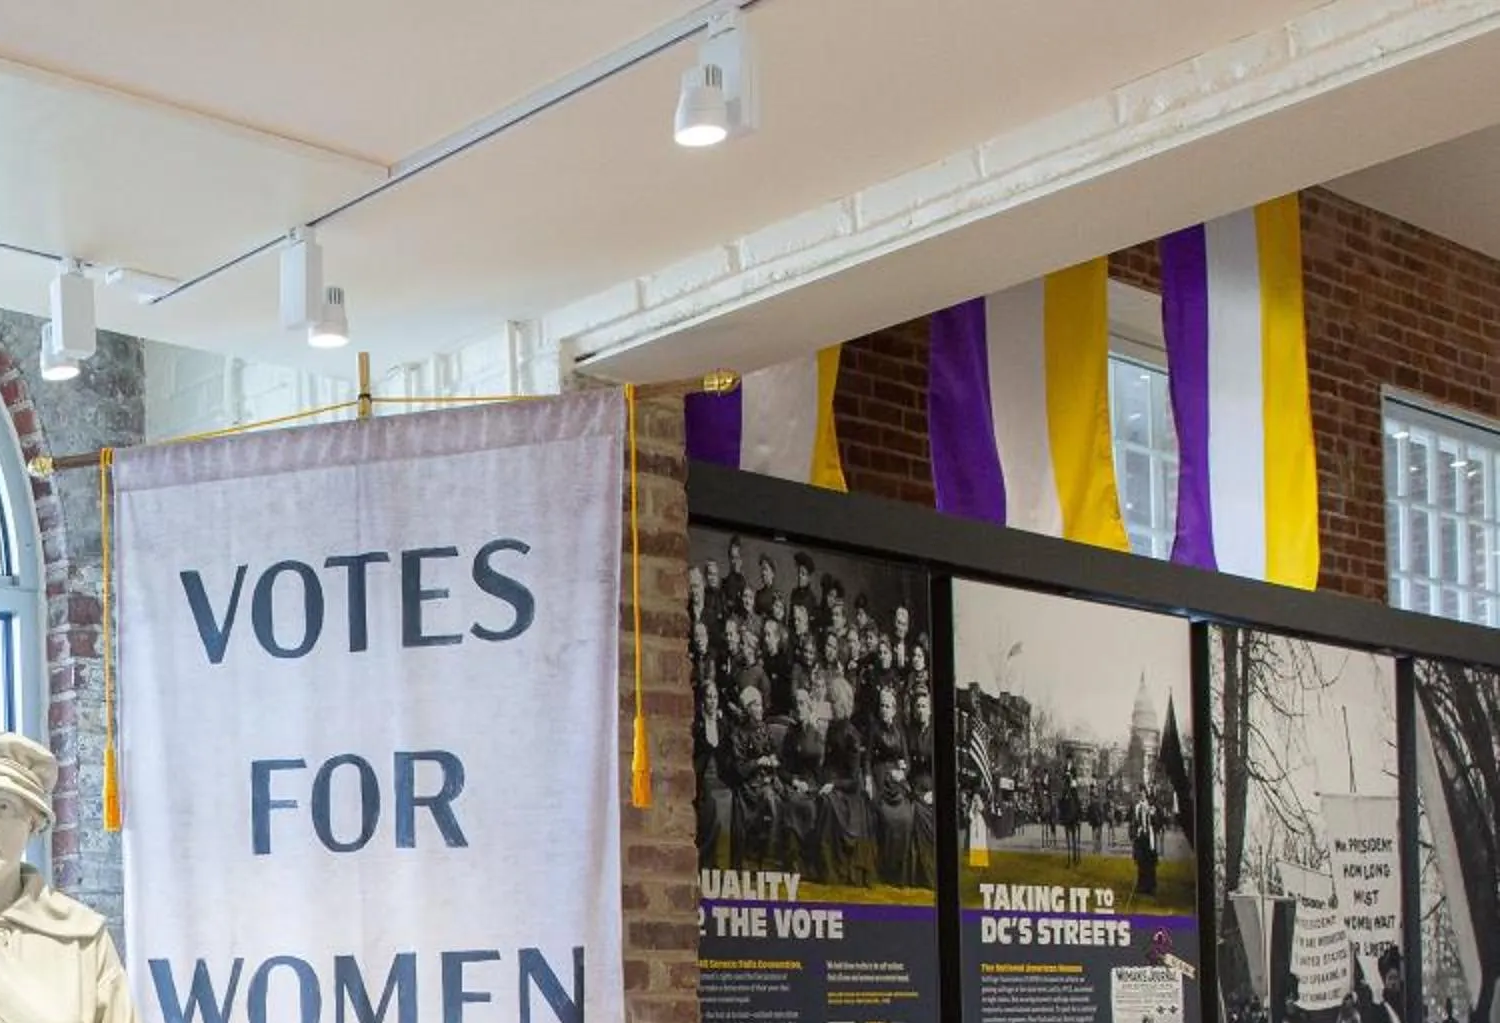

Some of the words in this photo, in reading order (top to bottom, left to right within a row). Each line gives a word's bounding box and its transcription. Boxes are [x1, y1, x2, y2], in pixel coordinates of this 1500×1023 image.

[180, 537, 536, 665] VOTES
[251, 749, 469, 856] FOR
[1347, 838, 1393, 854] PRESIDENT
[697, 868, 801, 902] UALITY
[1343, 863, 1362, 879] HOW
[1363, 863, 1391, 881] LONG
[980, 883, 1066, 913] TAKING
[1069, 887, 1091, 914] IT
[1093, 887, 1114, 908] TO
[711, 904, 768, 938] THE
[773, 907, 844, 940] VOTE
[981, 916, 1033, 945] DC'S
[1037, 917, 1132, 946] STREETS
